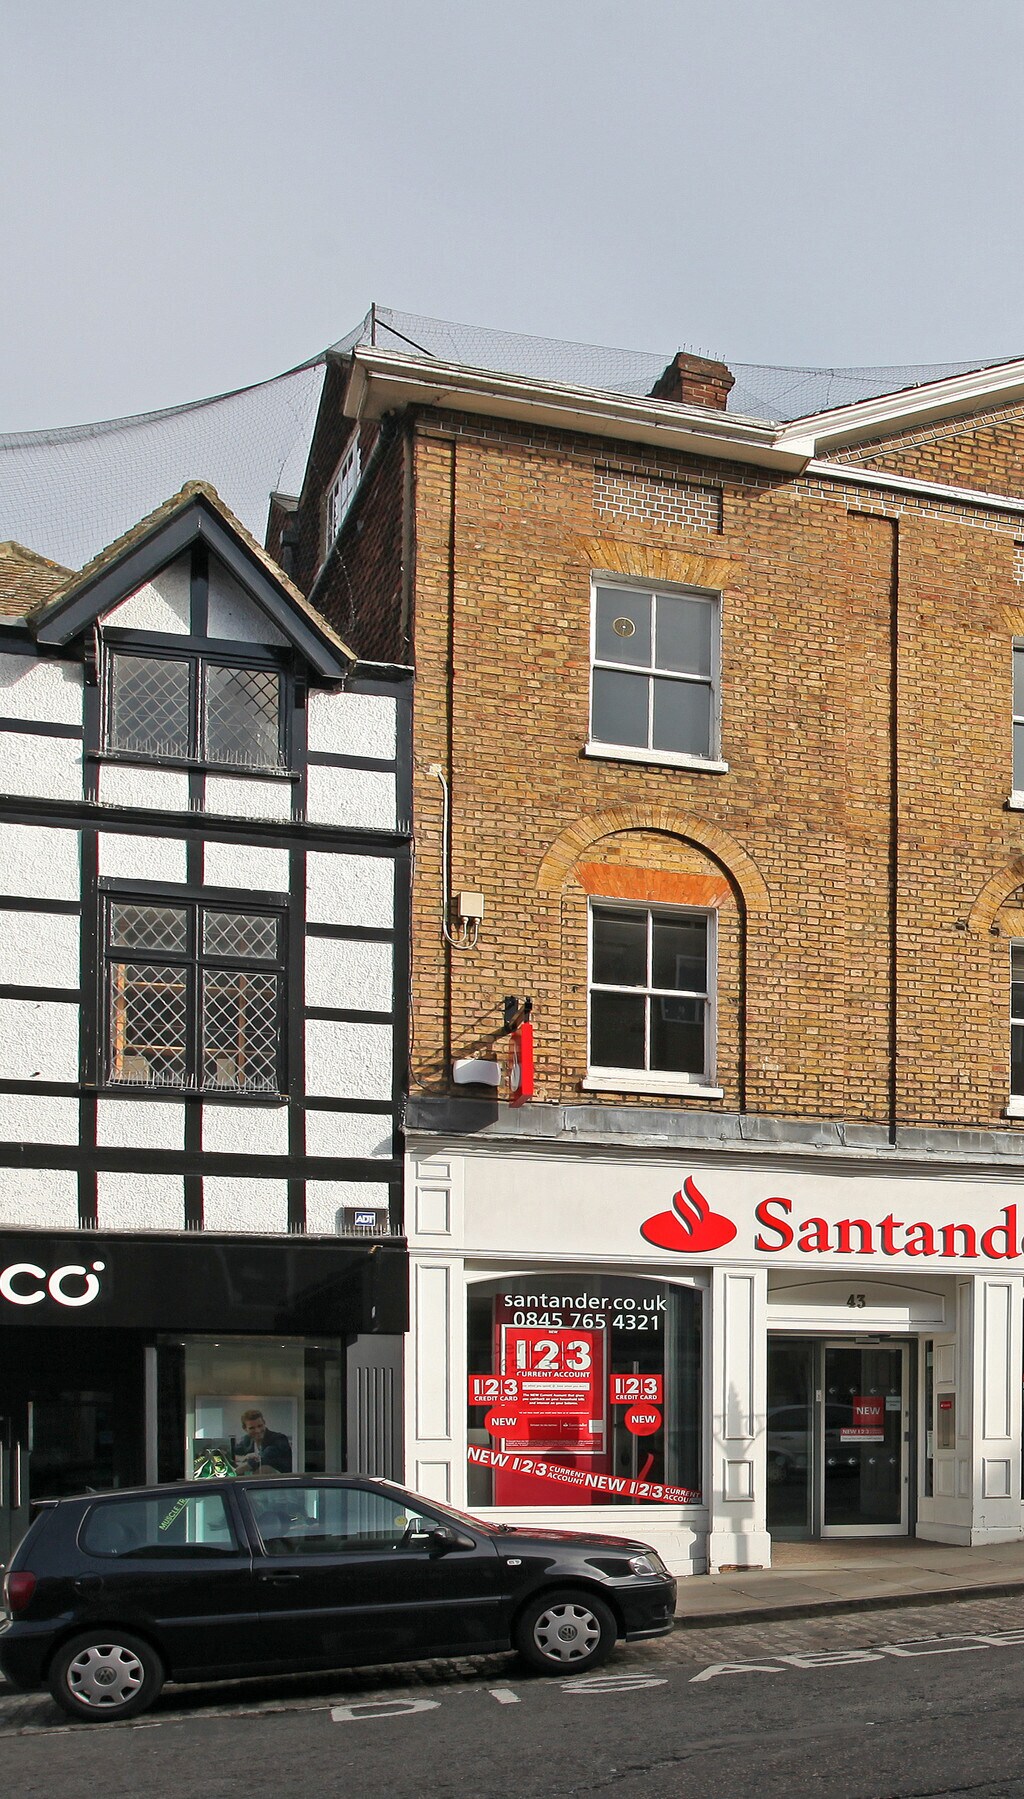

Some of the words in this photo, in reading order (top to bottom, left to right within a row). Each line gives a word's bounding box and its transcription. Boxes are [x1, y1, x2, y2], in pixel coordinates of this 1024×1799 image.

[356, 1214, 375, 1224] ADT
[504, 1292, 667, 1311] santander.co.uk
[847, 1294, 866, 1308] 43
[513, 1311, 562, 1328] 0845
[569, 1313, 606, 1329] 765
[612, 1314, 658, 1331] 4321
[856, 1406, 881, 1415] NEW
[491, 1417, 517, 1426] NEW
[631, 1415, 656, 1424] NEW
[467, 1447, 509, 1468] NEW
[547, 1472, 584, 1485] ACCOUNT
[549, 1465, 586, 1479] CURRENT
[584, 1473, 626, 1493] NEW
[665, 1487, 700, 1498] CURRENT
[159, 1503, 181, 1531] MUSCLE
